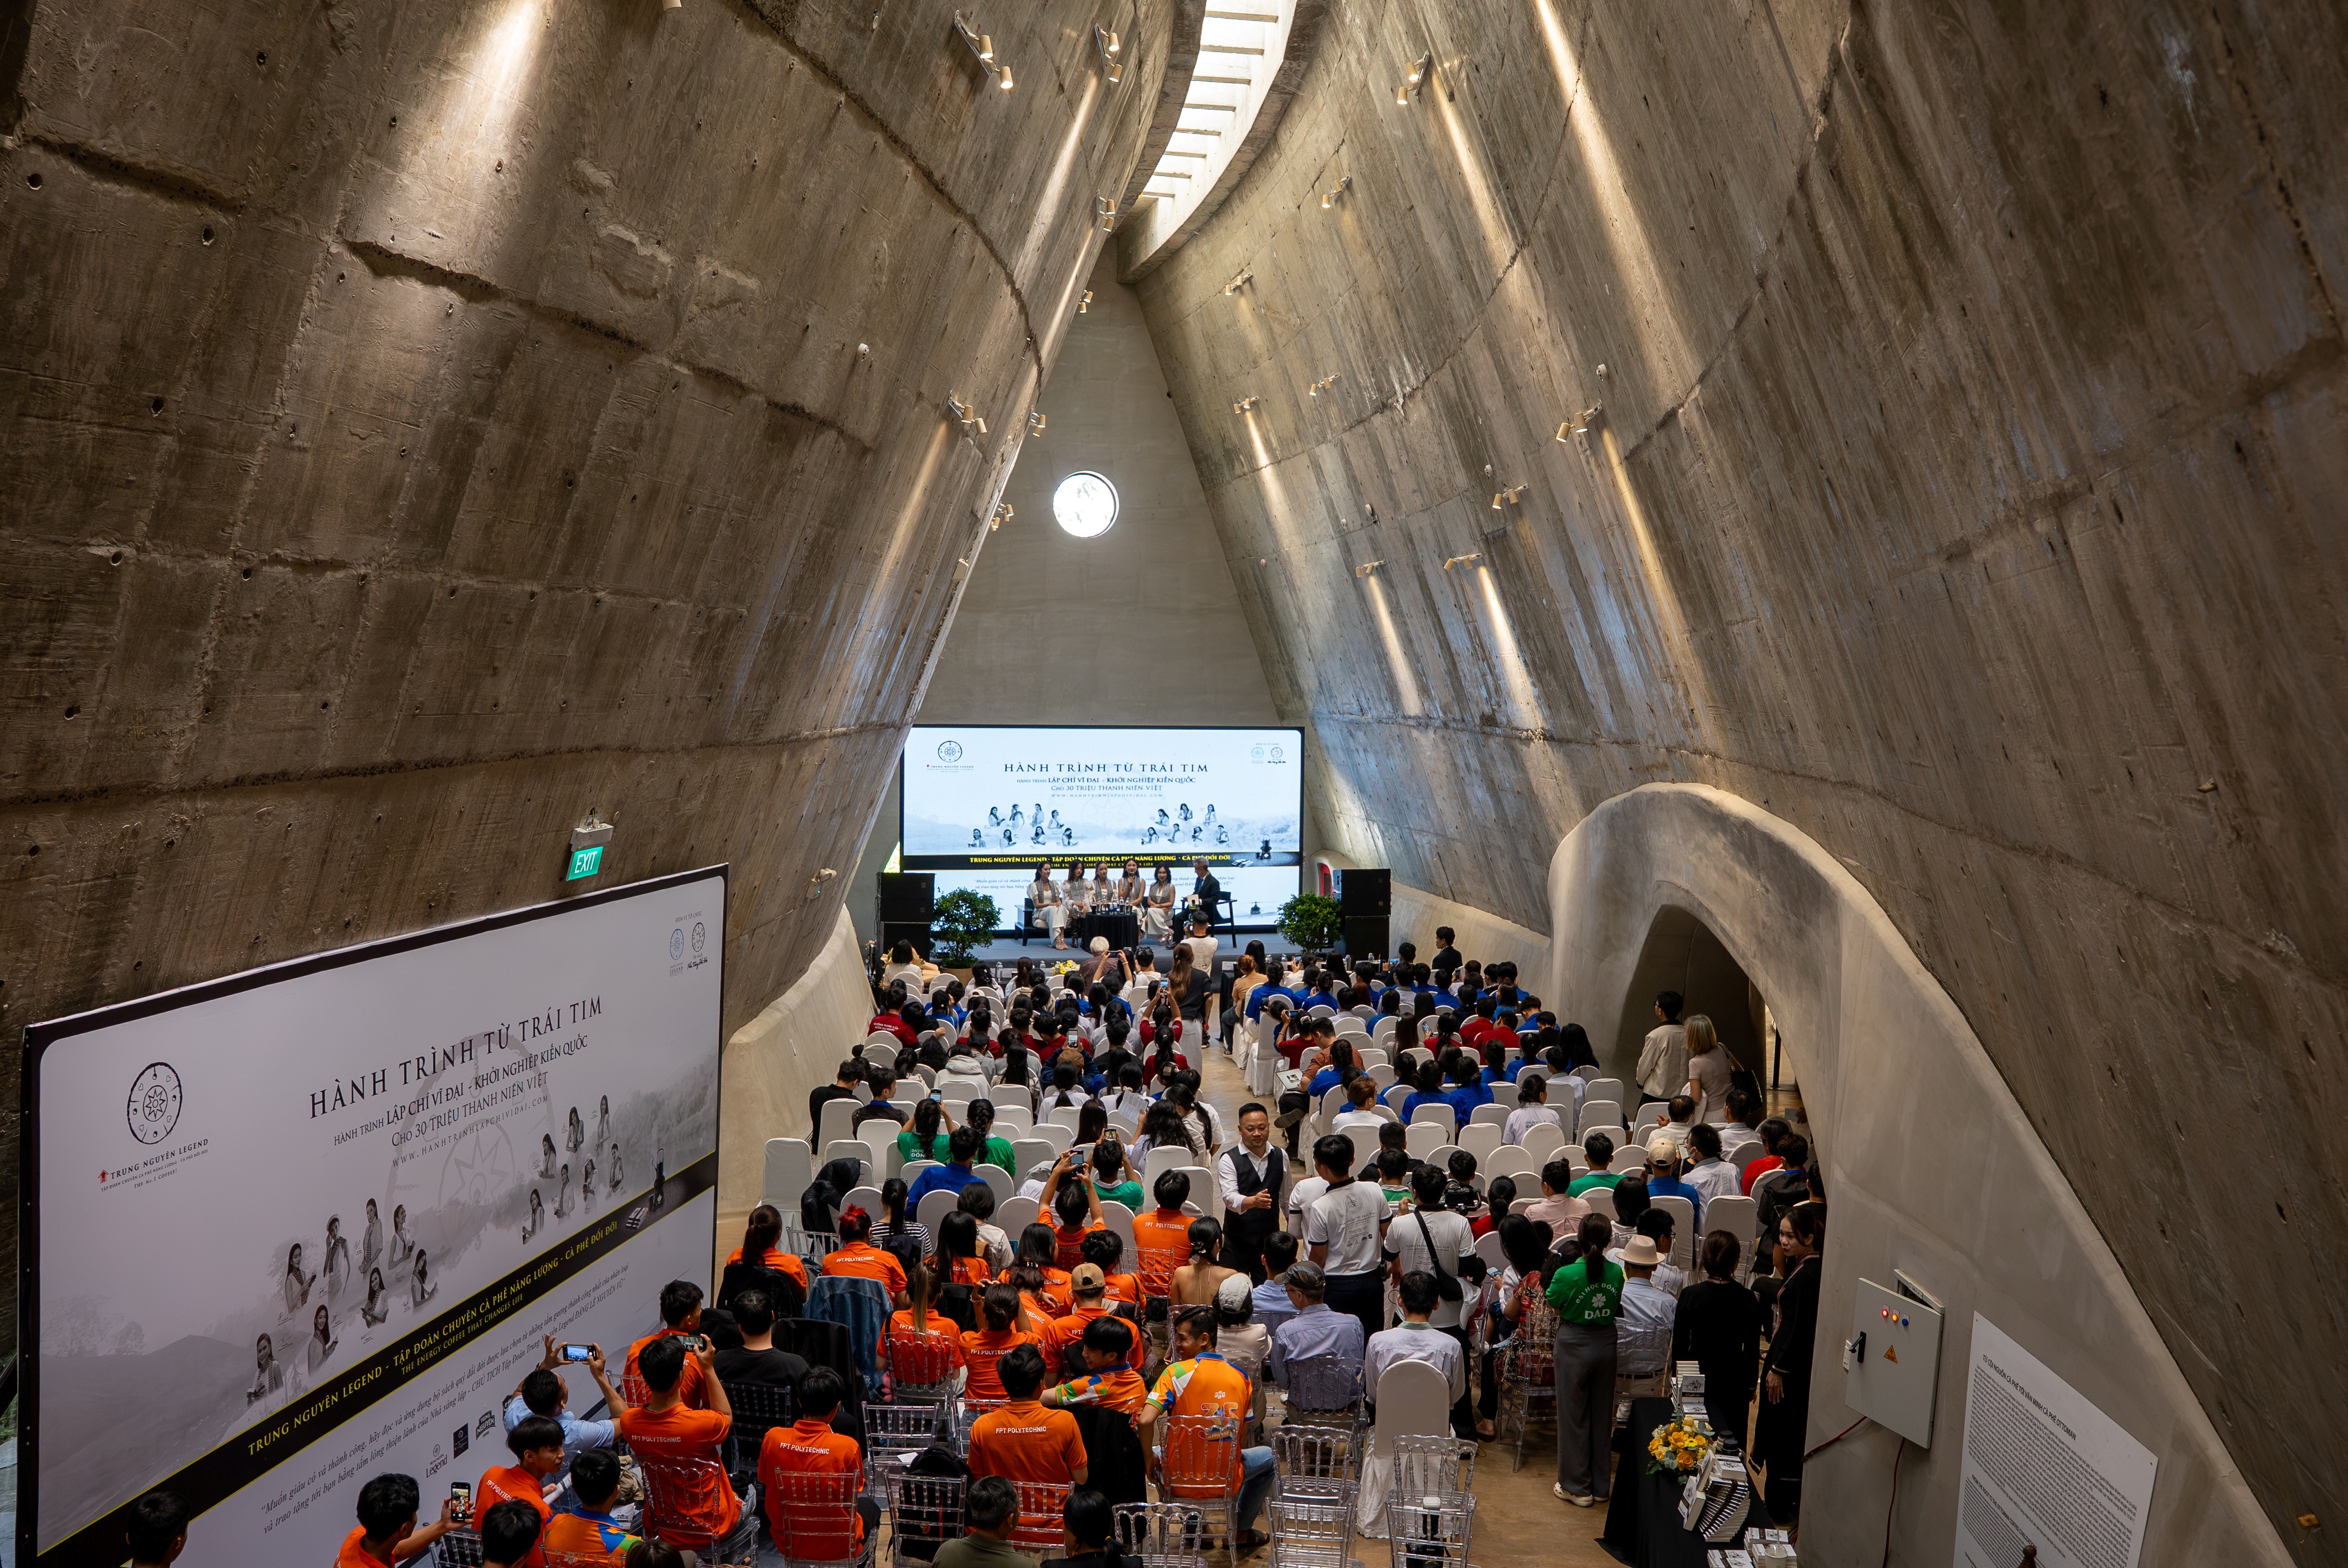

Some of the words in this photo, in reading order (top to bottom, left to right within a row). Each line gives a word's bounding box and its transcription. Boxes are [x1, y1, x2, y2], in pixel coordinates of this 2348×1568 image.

[1005, 762, 1049, 772] HÀNH
[1057, 762, 1106, 772] TRÌNH
[1114, 762, 1133, 772] TỪ
[1140, 762, 1173, 772] TRÁI
[1181, 764, 1208, 772] TIM
[574, 851, 598, 874] EXIT
[310, 1069, 387, 1118] HÀNH
[399, 1039, 473, 1085] TRÌNH
[484, 1023, 509, 1054] TỪ
[519, 1007, 560, 1041] TRÁI
[570, 996, 601, 1023] TIM
[334, 1128, 357, 1146] HÀNH
[360, 1118, 384, 1134] TRÌNH
[387, 1105, 405, 1125] LẬP
[409, 1092, 429, 1115] CHÍ
[431, 1089, 442, 1105] VĨ
[446, 1082, 464, 1101] ĐẠI
[475, 1067, 500, 1090] KHỞI
[503, 1054, 538, 1079] NGHIỆP
[541, 1044, 560, 1064] KIẾN
[563, 1034, 587, 1055] QUỐC
[416, 1122, 426, 1137] 30
[430, 1108, 459, 1131] TRIỆU
[462, 1092, 497, 1117] THANH
[501, 1082, 523, 1102] NIÊN
[527, 1072, 548, 1090] VIỆT
[111, 1164, 139, 1179] TRUNG
[143, 1151, 174, 1168] NGUYÊN
[179, 1139, 208, 1154] LEGEND
[402, 1361, 414, 1374] THE
[418, 1345, 441, 1365] ENERGY
[444, 1330, 465, 1348] COFFEE
[467, 1319, 482, 1333] THAT
[485, 1302, 510, 1322] CHANGES
[513, 1294, 522, 1305] LIFE
[1585, 1309, 1610, 1319] DAD
[249, 1422, 289, 1454] TRUNG
[295, 1392, 337, 1428] NGUYÊN
[343, 1367, 381, 1397] LEGEND
[394, 1349, 410, 1366] TẬP
[414, 1331, 439, 1354] ĐOÀN
[443, 1308, 476, 1335] CHUYÊN
[480, 1299, 490, 1312] CÀ
[493, 1287, 507, 1305] PHÊ
[511, 1275, 531, 1294] NĂNG
[534, 1258, 558, 1280] LƯỢNG
[566, 1247, 574, 1259] CÀ
[577, 1237, 588, 1253] PHÊ
[591, 1229, 603, 1244] ĐỔI
[606, 1221, 616, 1235] ĐỜI
[264, 1520, 272, 1533] và
[276, 1511, 291, 1526] trao
[294, 1498, 309, 1514] tặng
[312, 1487, 321, 1502] tới
[323, 1480, 336, 1493] bạn
[338, 1467, 354, 1483] bằng
[370, 1447, 384, 1461] lòng
[386, 1435, 401, 1451] thiện
[403, 1423, 416, 1439] lành
[430, 1406, 441, 1420] Nhà
[443, 1398, 456, 1411] sáng
[527, 1340, 539, 1353] Trung
[477, 1417, 494, 1435] NGUYÊN
[480, 1413, 491, 1423] TRUNG
[2032, 1396, 2043, 1411] MINH
[2057, 1419, 2076, 1441] OTTOMAN
[289, 1482, 305, 1500] giàu
[308, 1472, 316, 1485] có
[318, 1465, 326, 1478] và
[328, 1452, 347, 1471] thành
[369, 1432, 380, 1444] hãy
[382, 1423, 393, 1435] đọc
[395, 1415, 402, 1426] và
[417, 1398, 431, 1412] dụng
[441, 1381, 454, 1396] sách
[791, 1444, 830, 1454] POLYTECHNIC
[426, 1454, 447, 1478] Legend
[486, 1479, 495, 1488] FPT
